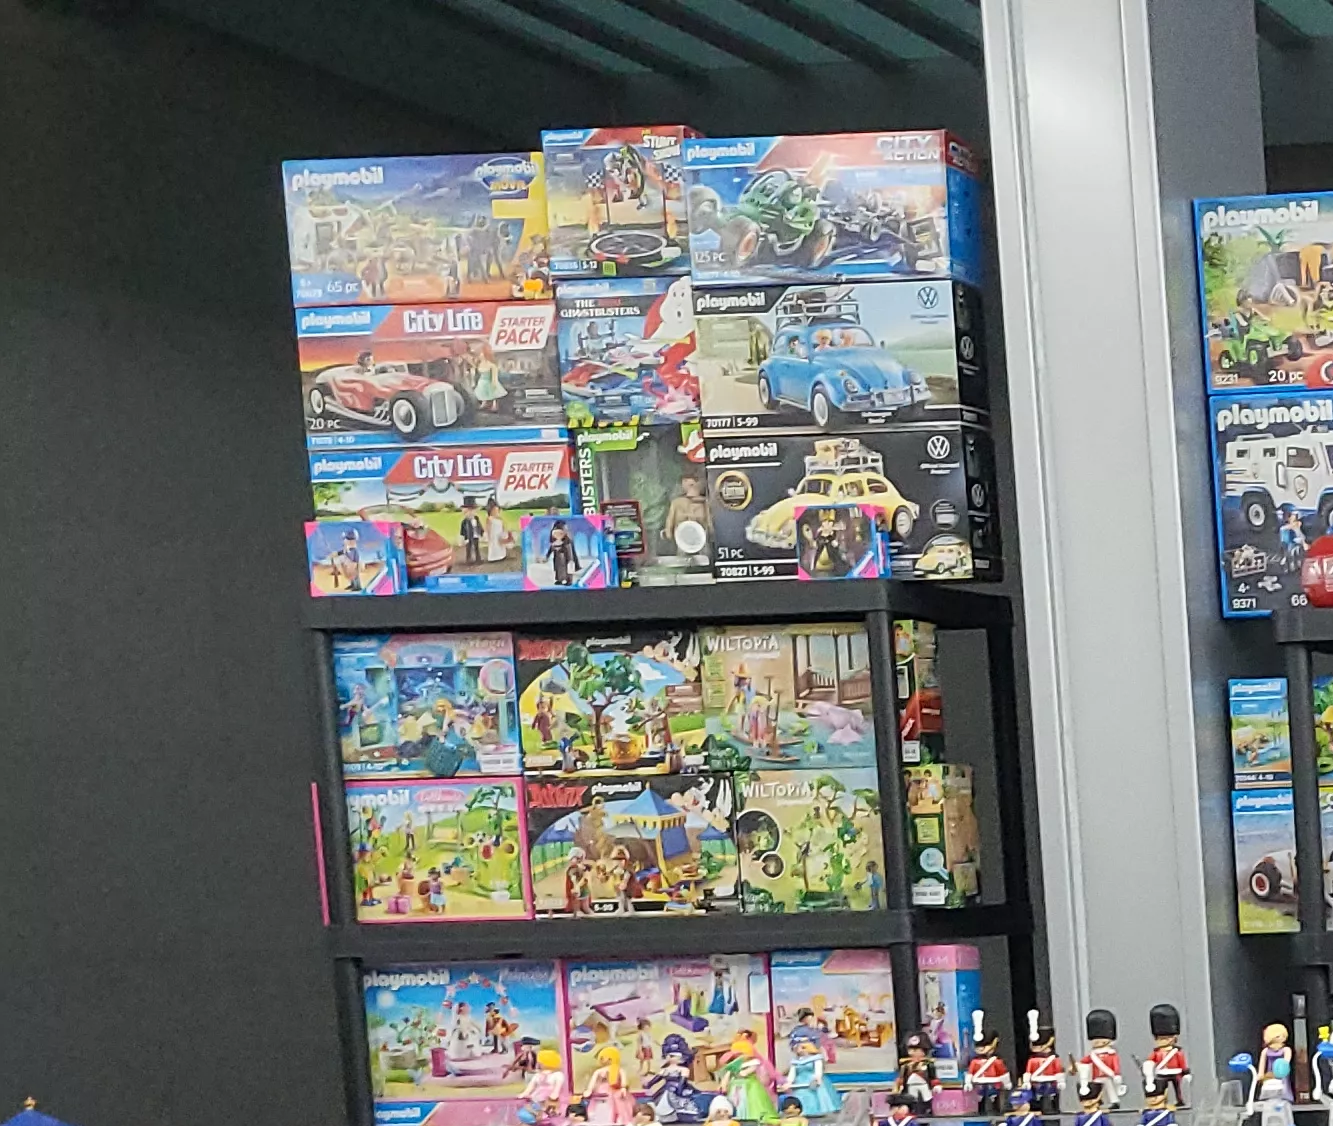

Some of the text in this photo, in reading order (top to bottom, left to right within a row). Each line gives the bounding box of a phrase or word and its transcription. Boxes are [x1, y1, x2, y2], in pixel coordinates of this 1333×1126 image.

[877, 134, 933, 151] CITY
[686, 142, 756, 163] playmobil
[883, 147, 941, 162] ACTION
[291, 166, 384, 190] playmobil
[1202, 200, 1320, 233] playmobil
[696, 292, 766, 312] playmobil
[300, 312, 371, 330] playmobil
[403, 307, 484, 334] City Life
[499, 316, 546, 329] STARTER
[495, 327, 543, 346] PACK
[1267, 369, 1287, 383] 20
[1288, 370, 1305, 386] pc
[308, 418, 341, 430] 20 PC
[704, 416, 759, 428] 70177 5-99
[1217, 399, 1333, 432] playmobil
[577, 429, 633, 445] playmobil
[709, 442, 778, 462] playmobil
[312, 456, 383, 475] playmobil
[413, 453, 493, 479] City Life
[508, 461, 555, 474] STARTER
[503, 474, 553, 492] PACK
[591, 781, 643, 796] playmobil
[363, 968, 450, 989] playmobil
[570, 967, 659, 988] playmobil
